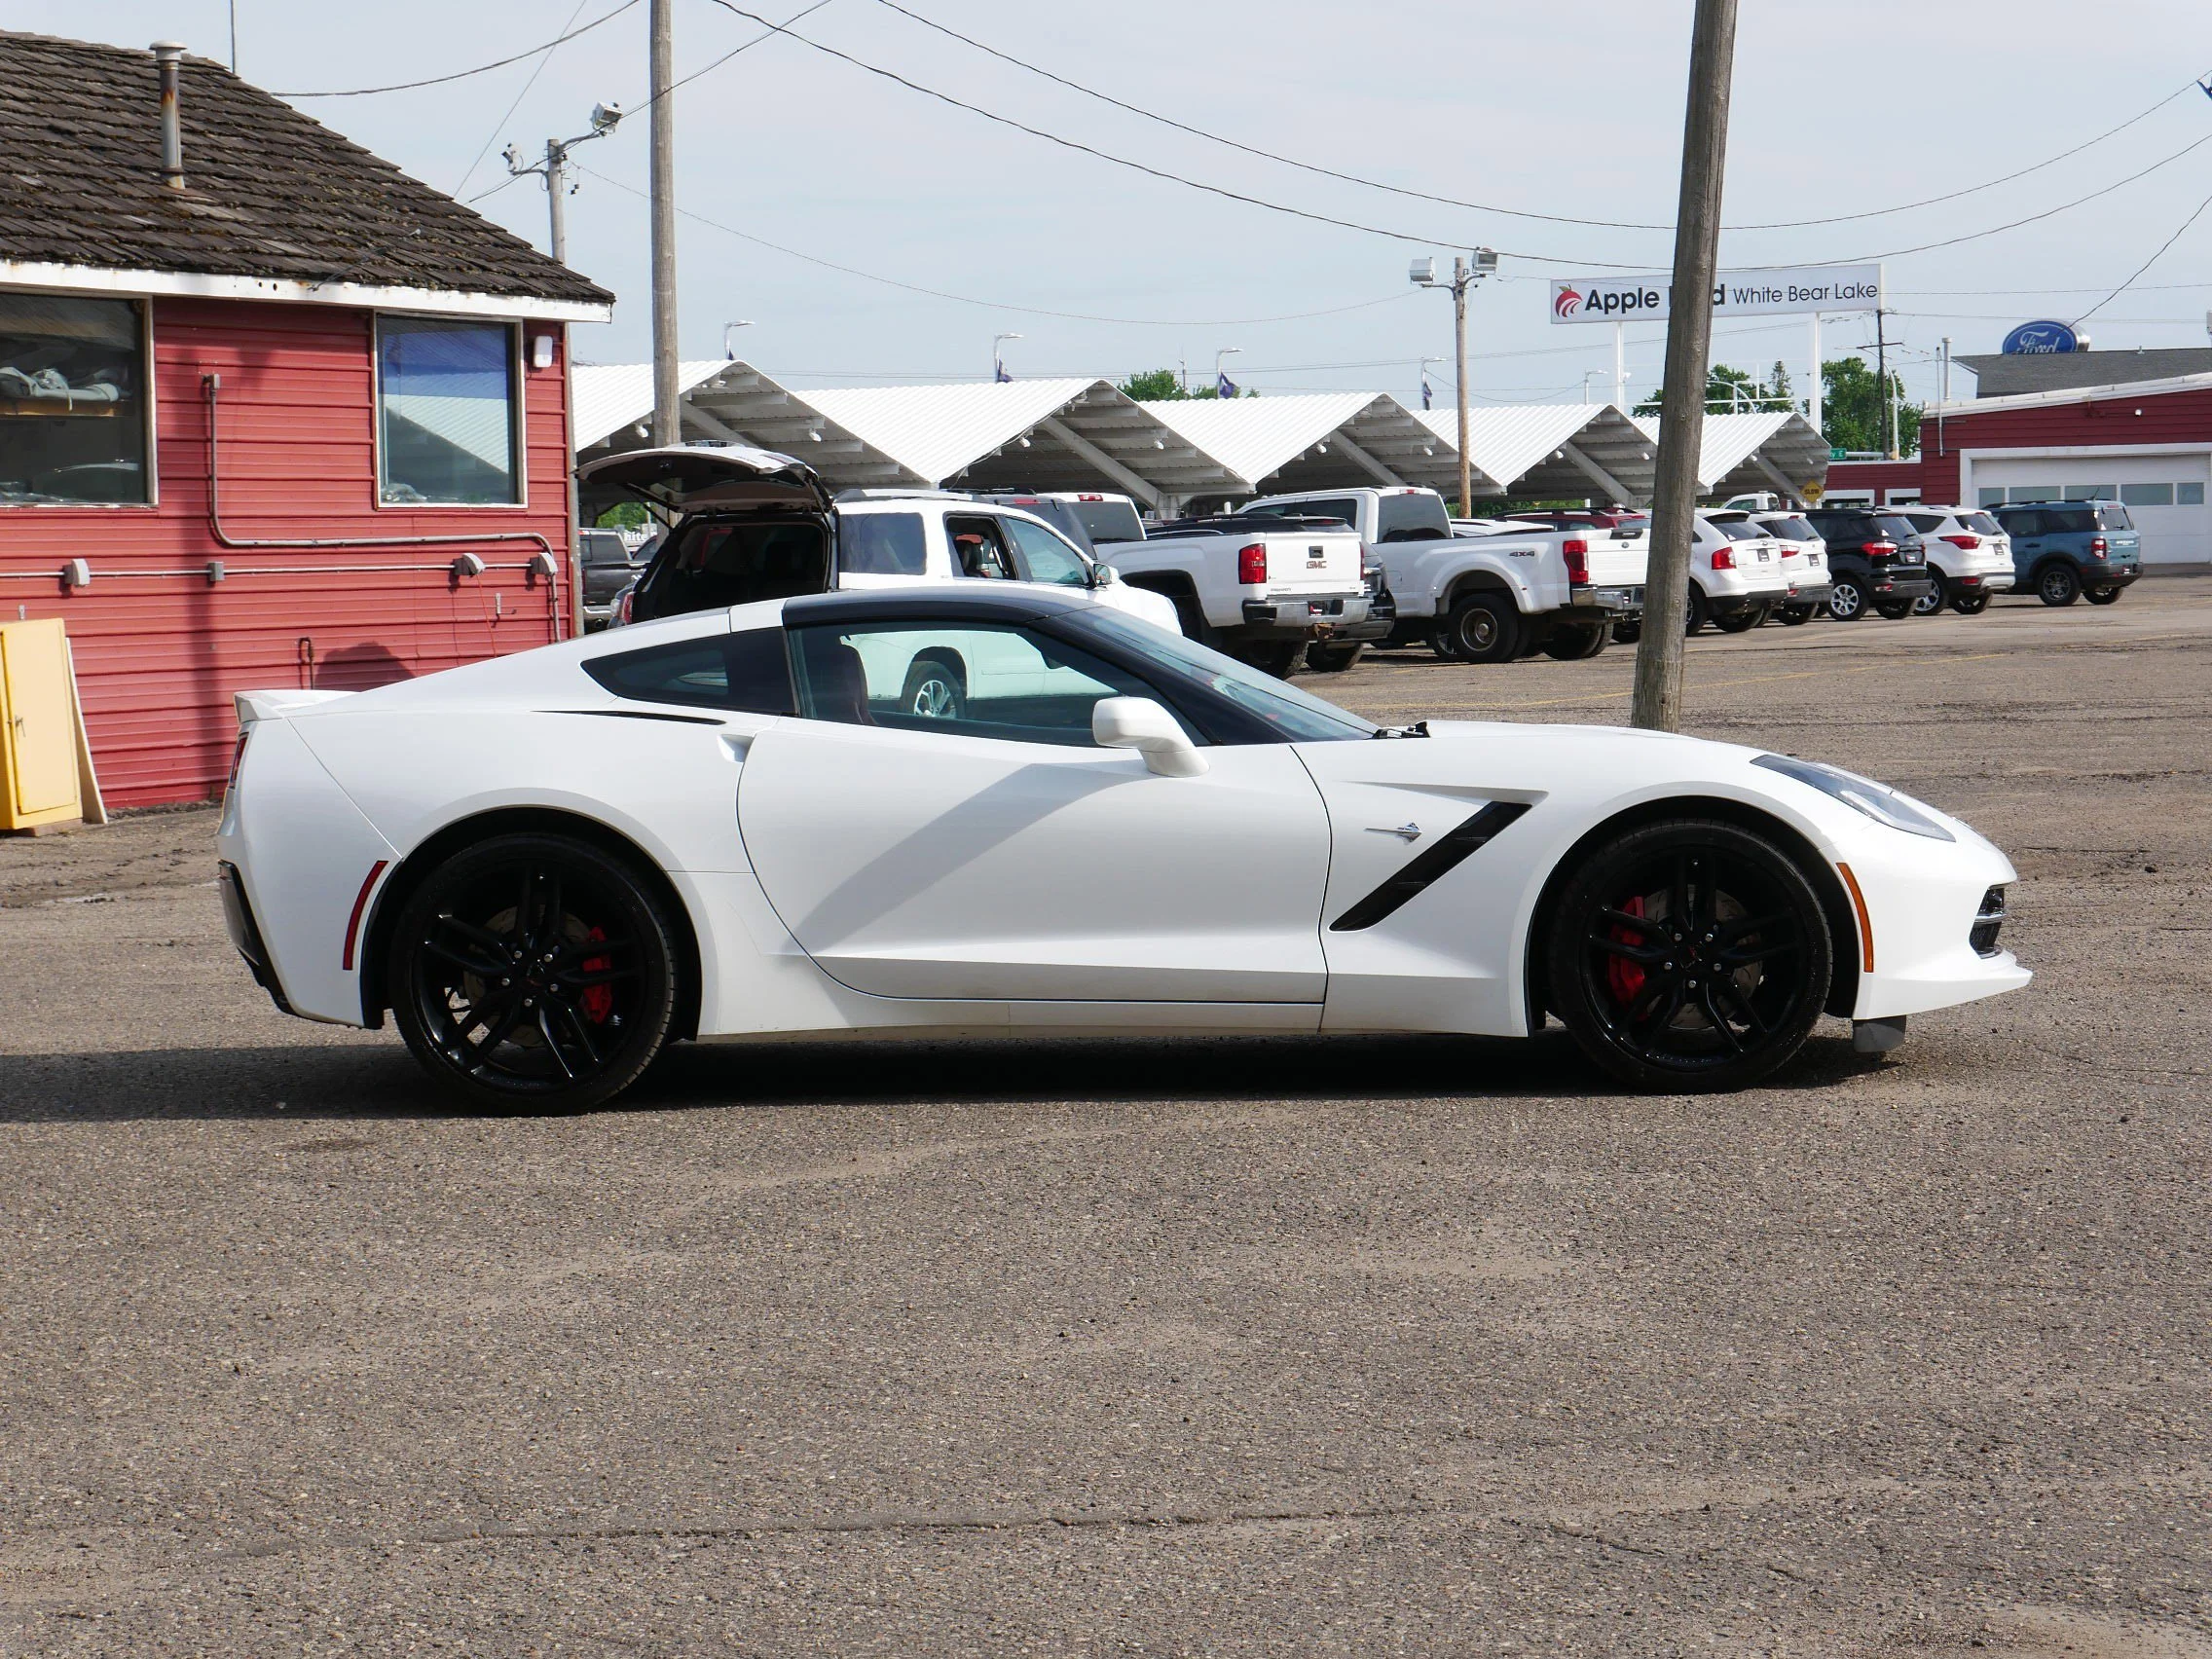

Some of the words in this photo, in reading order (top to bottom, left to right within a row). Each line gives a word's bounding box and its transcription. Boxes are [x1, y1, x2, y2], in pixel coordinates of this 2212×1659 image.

[1585, 287, 1660, 314] Apple
[1733, 286, 1783, 304] White
[1788, 285, 1830, 302] Bear
[1835, 282, 1878, 300] Lake
[1306, 560, 1327, 570] GMC
